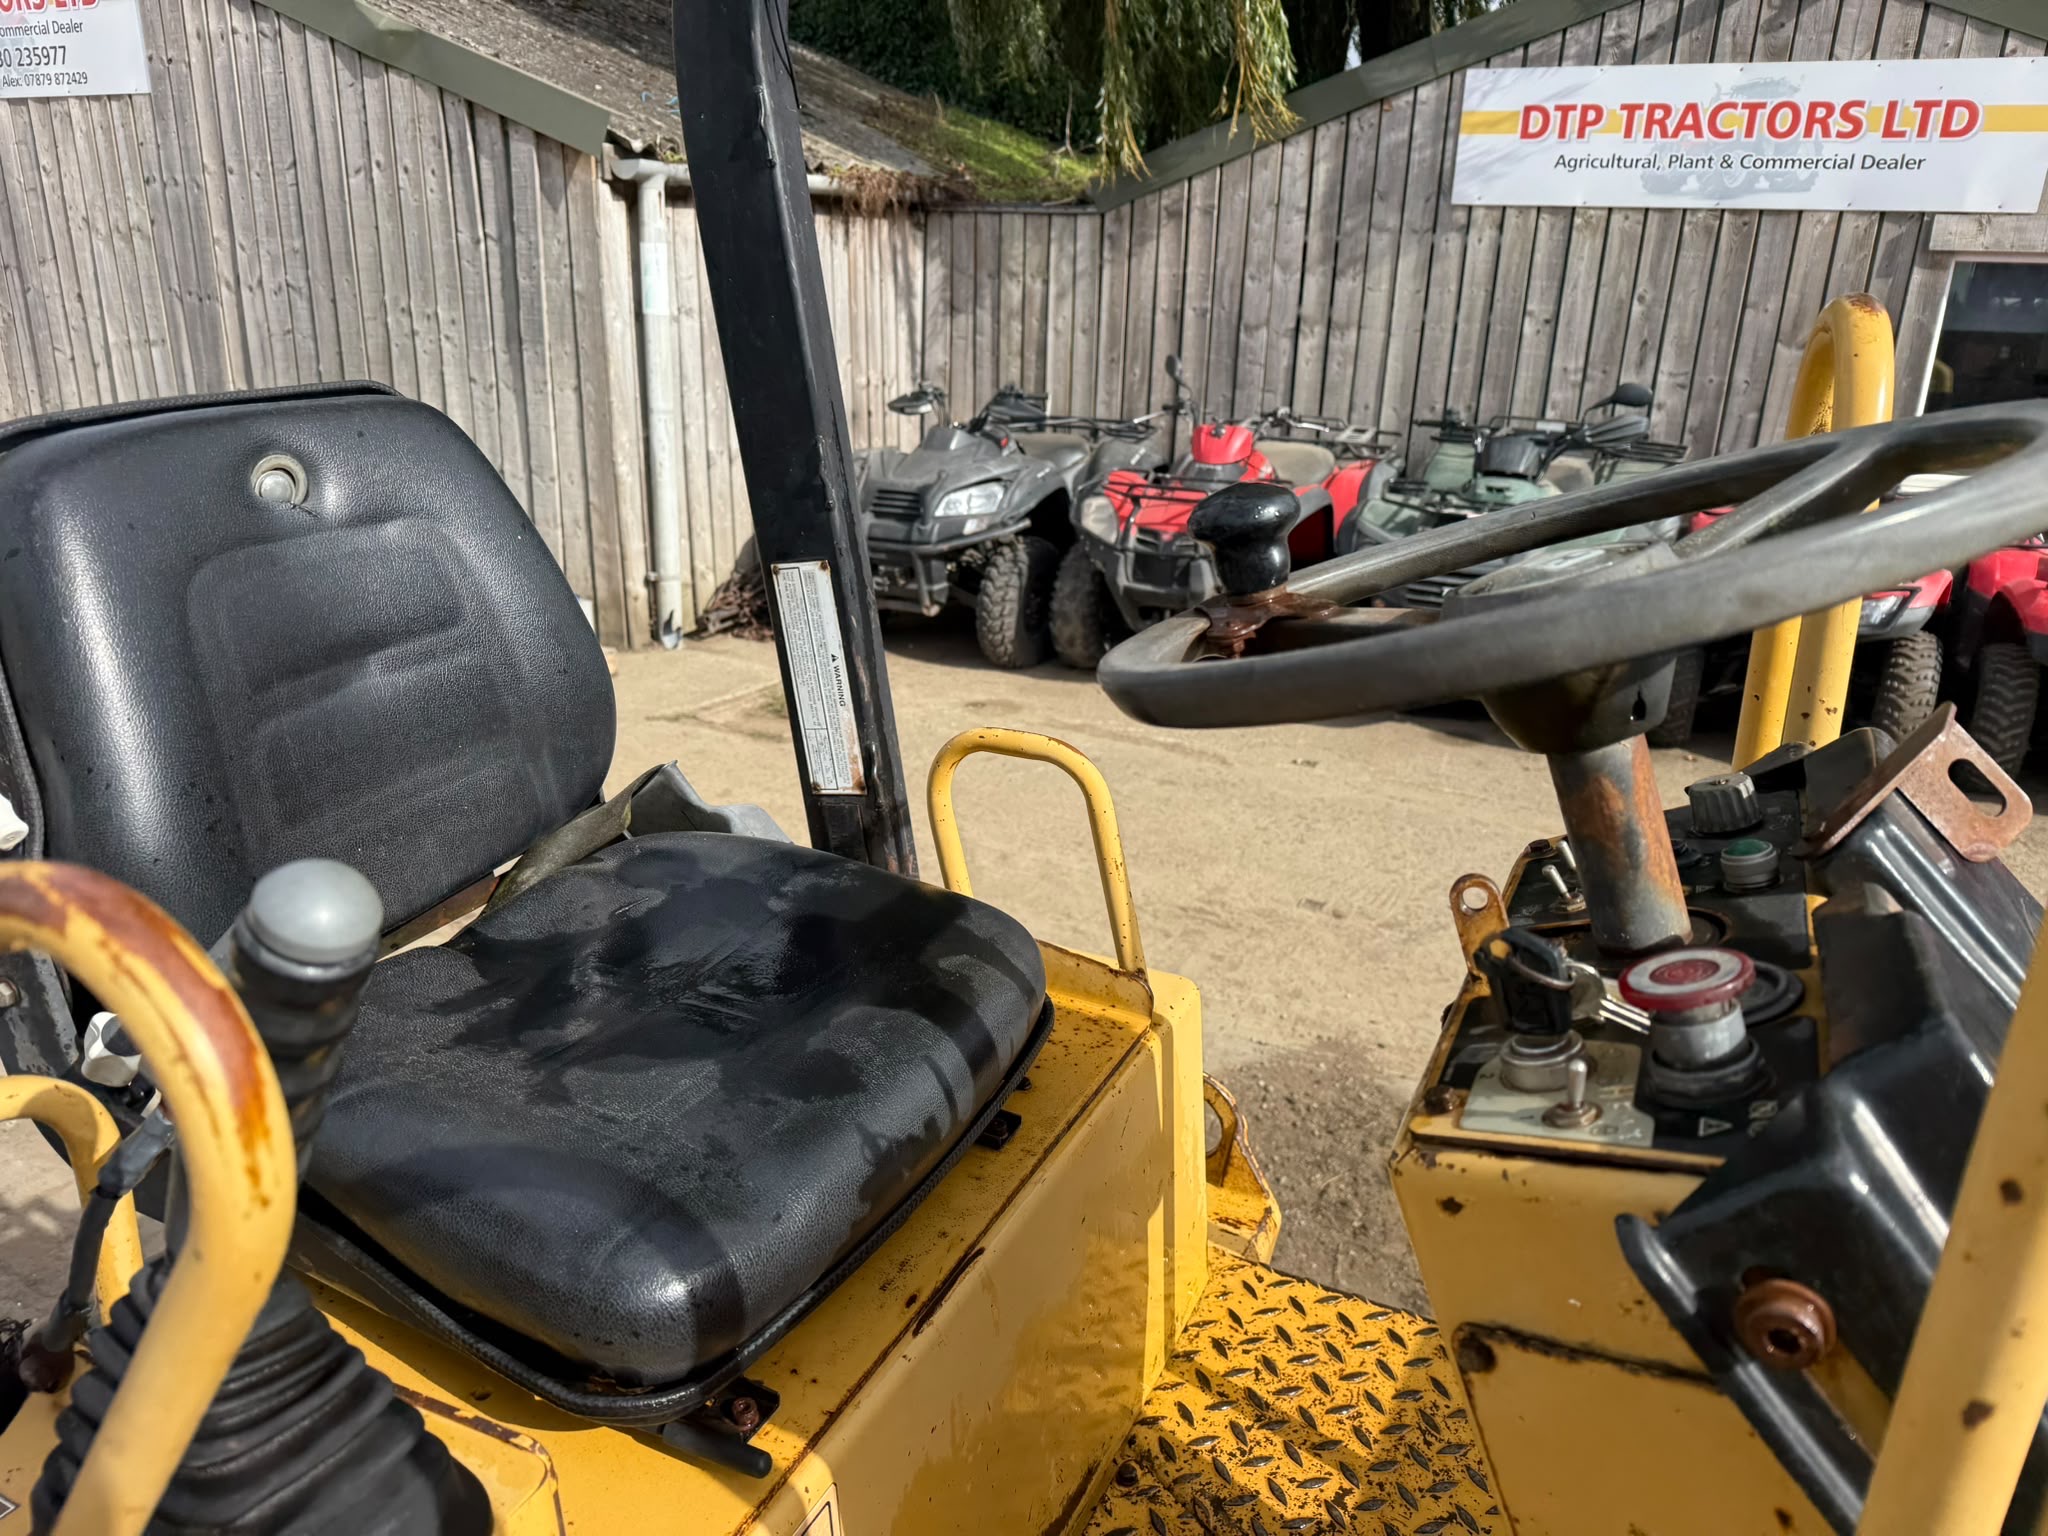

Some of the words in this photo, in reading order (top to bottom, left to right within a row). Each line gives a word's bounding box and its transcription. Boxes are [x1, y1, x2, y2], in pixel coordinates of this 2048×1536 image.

[52, 18, 83, 34] Dealer
[15, 45, 66, 67] 235977
[2, 74, 22, 87] Alex:
[24, 73, 52, 86] 07879
[54, 71, 88, 86] 872429
[1519, 103, 1605, 140] DTP
[1619, 99, 1867, 140] TRACTORS
[1881, 99, 1981, 139] LTD
[1554, 153, 1661, 173] Agricultural,
[1667, 153, 1715, 169] Plant
[1720, 155, 1733, 169] &
[1740, 154, 1855, 170] Commercial
[1861, 154, 1926, 170] Dealer
[833, 665, 846, 707] WARNING
